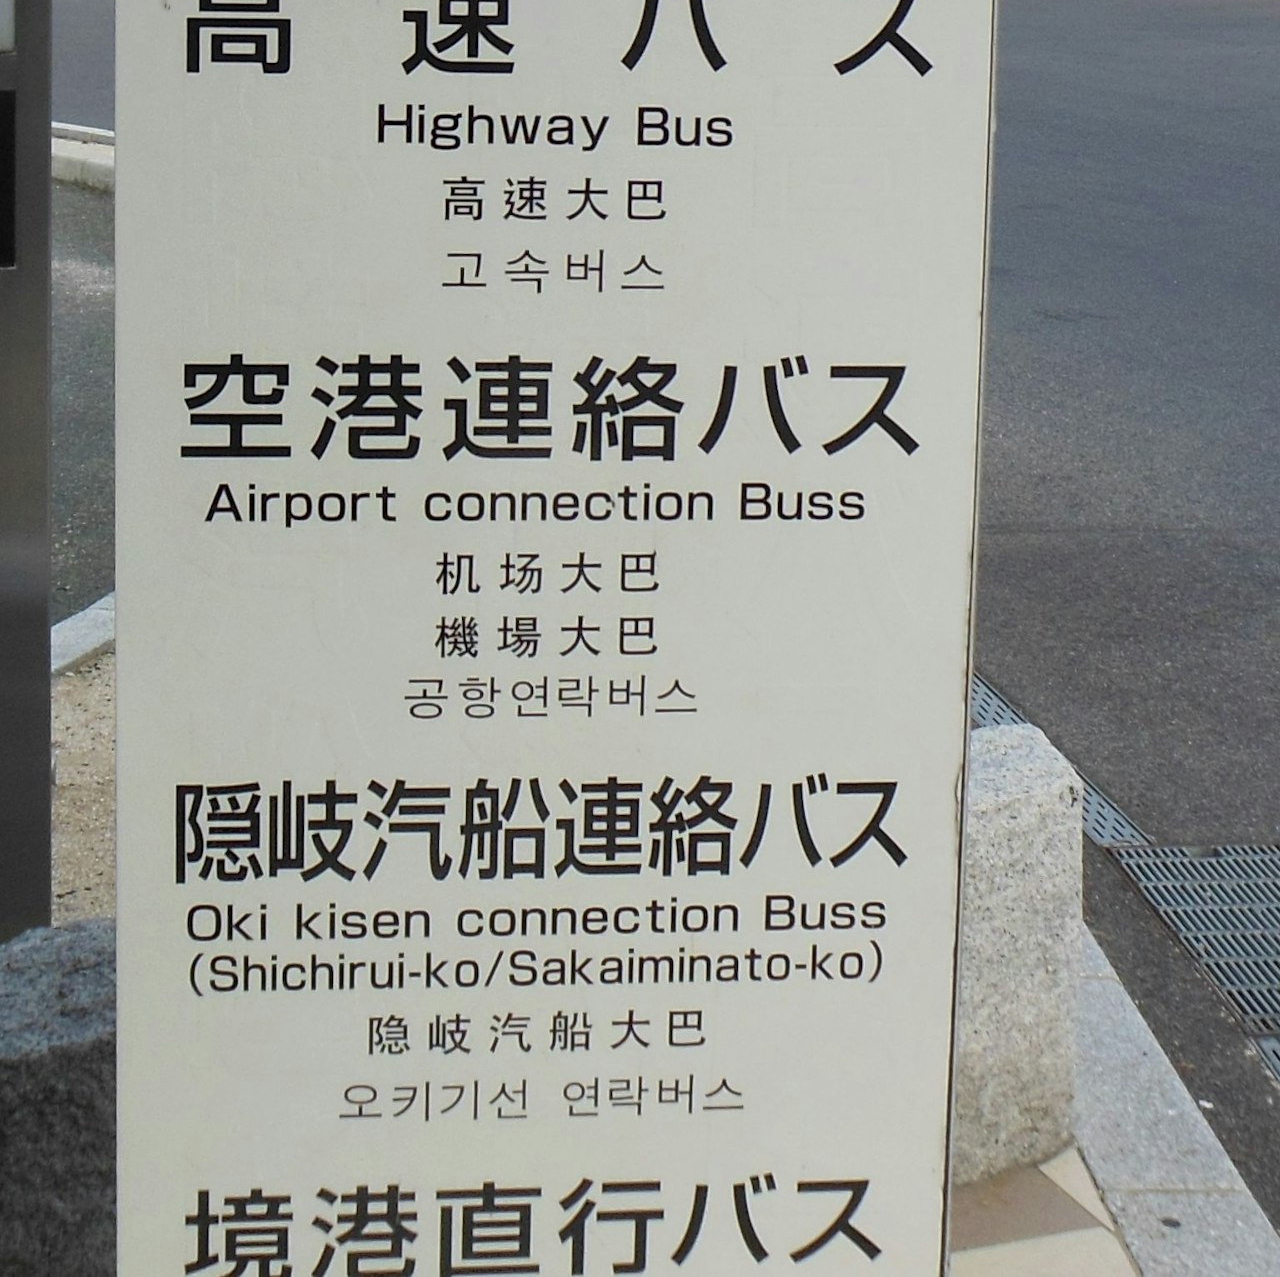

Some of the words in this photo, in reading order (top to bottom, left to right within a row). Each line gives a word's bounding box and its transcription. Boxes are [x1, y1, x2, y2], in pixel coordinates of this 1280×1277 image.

[377, 103, 610, 152] Highway
[637, 106, 733, 147] Bus
[442, 175, 667, 221] 高速大巴
[441, 249, 665, 294] 고속버스
[180, 353, 920, 462] 空港連絡バス
[204, 483, 397, 528] Airport
[424, 482, 714, 522] connection
[740, 482, 865, 521] Buss
[435, 550, 660, 595] 机场大巴
[434, 615, 658, 659] 機場大巴
[404, 674, 698, 720] 공항연락버스
[175, 773, 908, 885] 隠岐汽船連絡バス
[186, 903, 268, 942] Oki
[296, 902, 430, 940] kisen
[457, 896, 739, 937] connection
[764, 894, 886, 931] Buss
[188, 939, 884, 997] (Shichirui-ko/Sakaiminato-ko)
[368, 1009, 706, 1056] 隐岐汽船大巴
[338, 1078, 528, 1122] 오키기선
[563, 1073, 744, 1117] 연락버스
[184, 1173, 882, 1277] 境港直行バス
